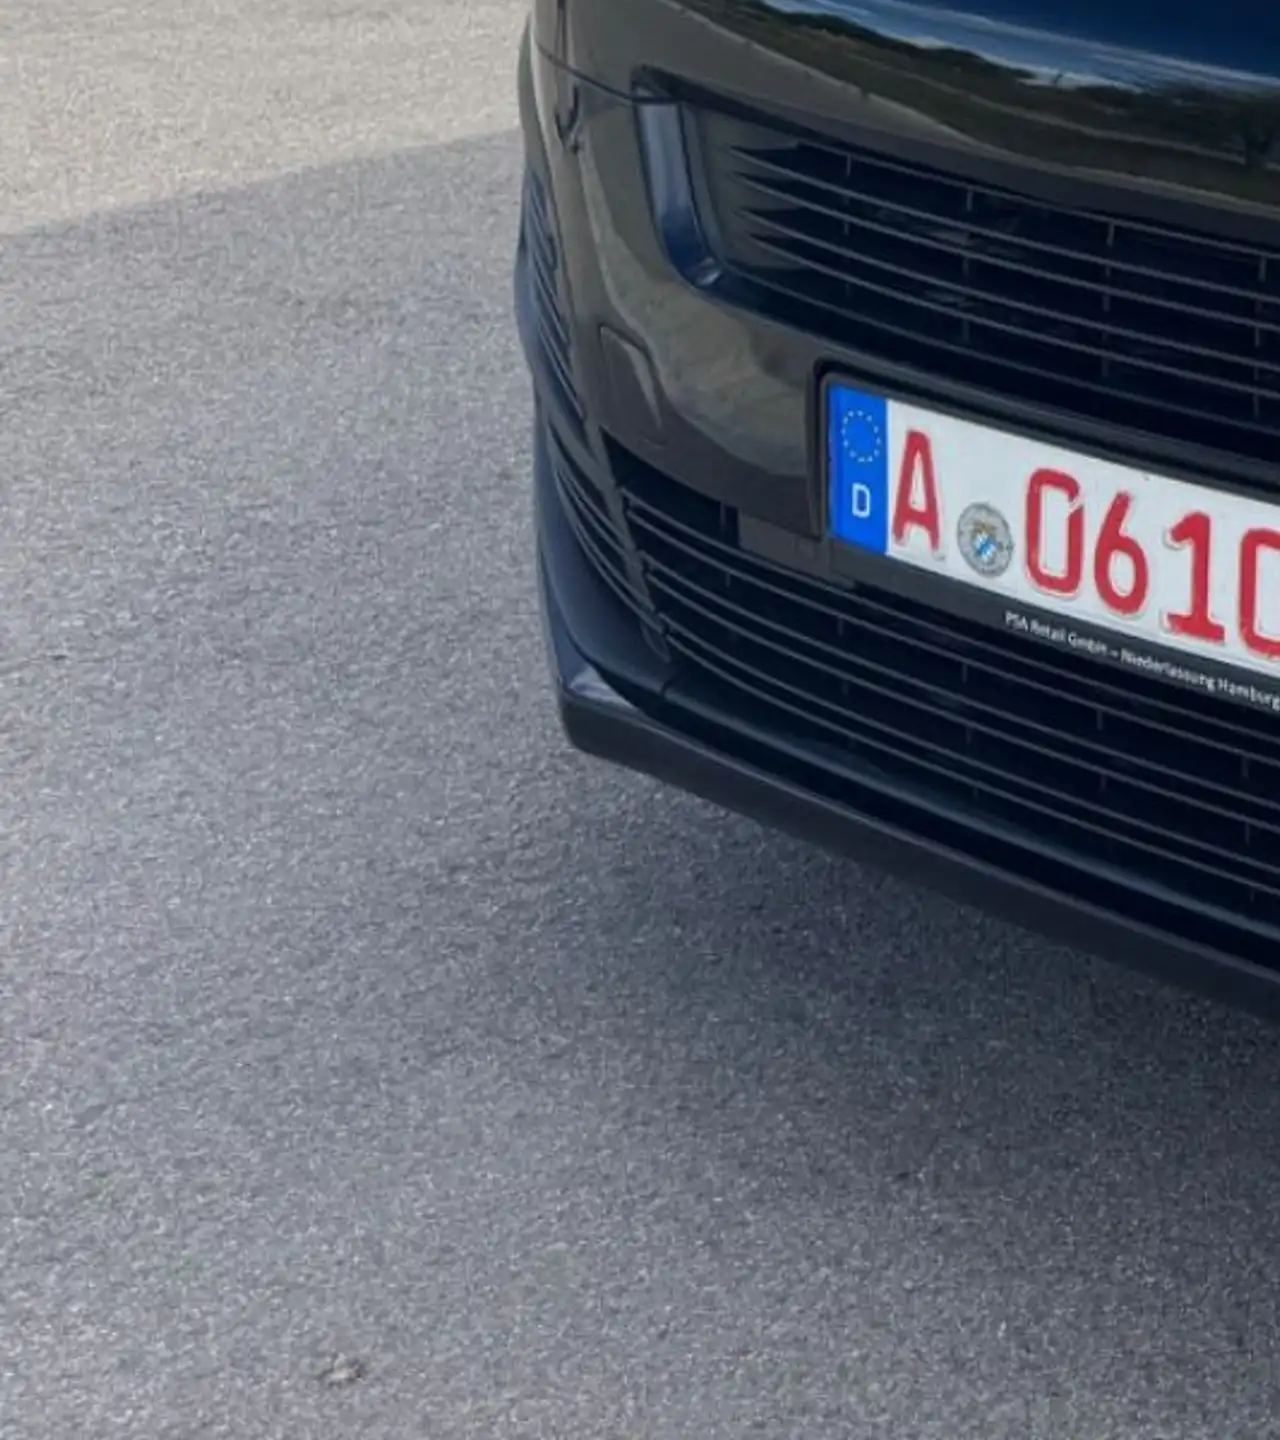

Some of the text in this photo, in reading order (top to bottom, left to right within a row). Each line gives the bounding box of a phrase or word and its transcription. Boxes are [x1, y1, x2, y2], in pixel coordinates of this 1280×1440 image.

[852, 482, 871, 519] D
[891, 429, 941, 552] A
[1004, 610, 1028, 632] PSA
[1030, 619, 1066, 641] Retail
[1120, 647, 1216, 692] Niederlassung
